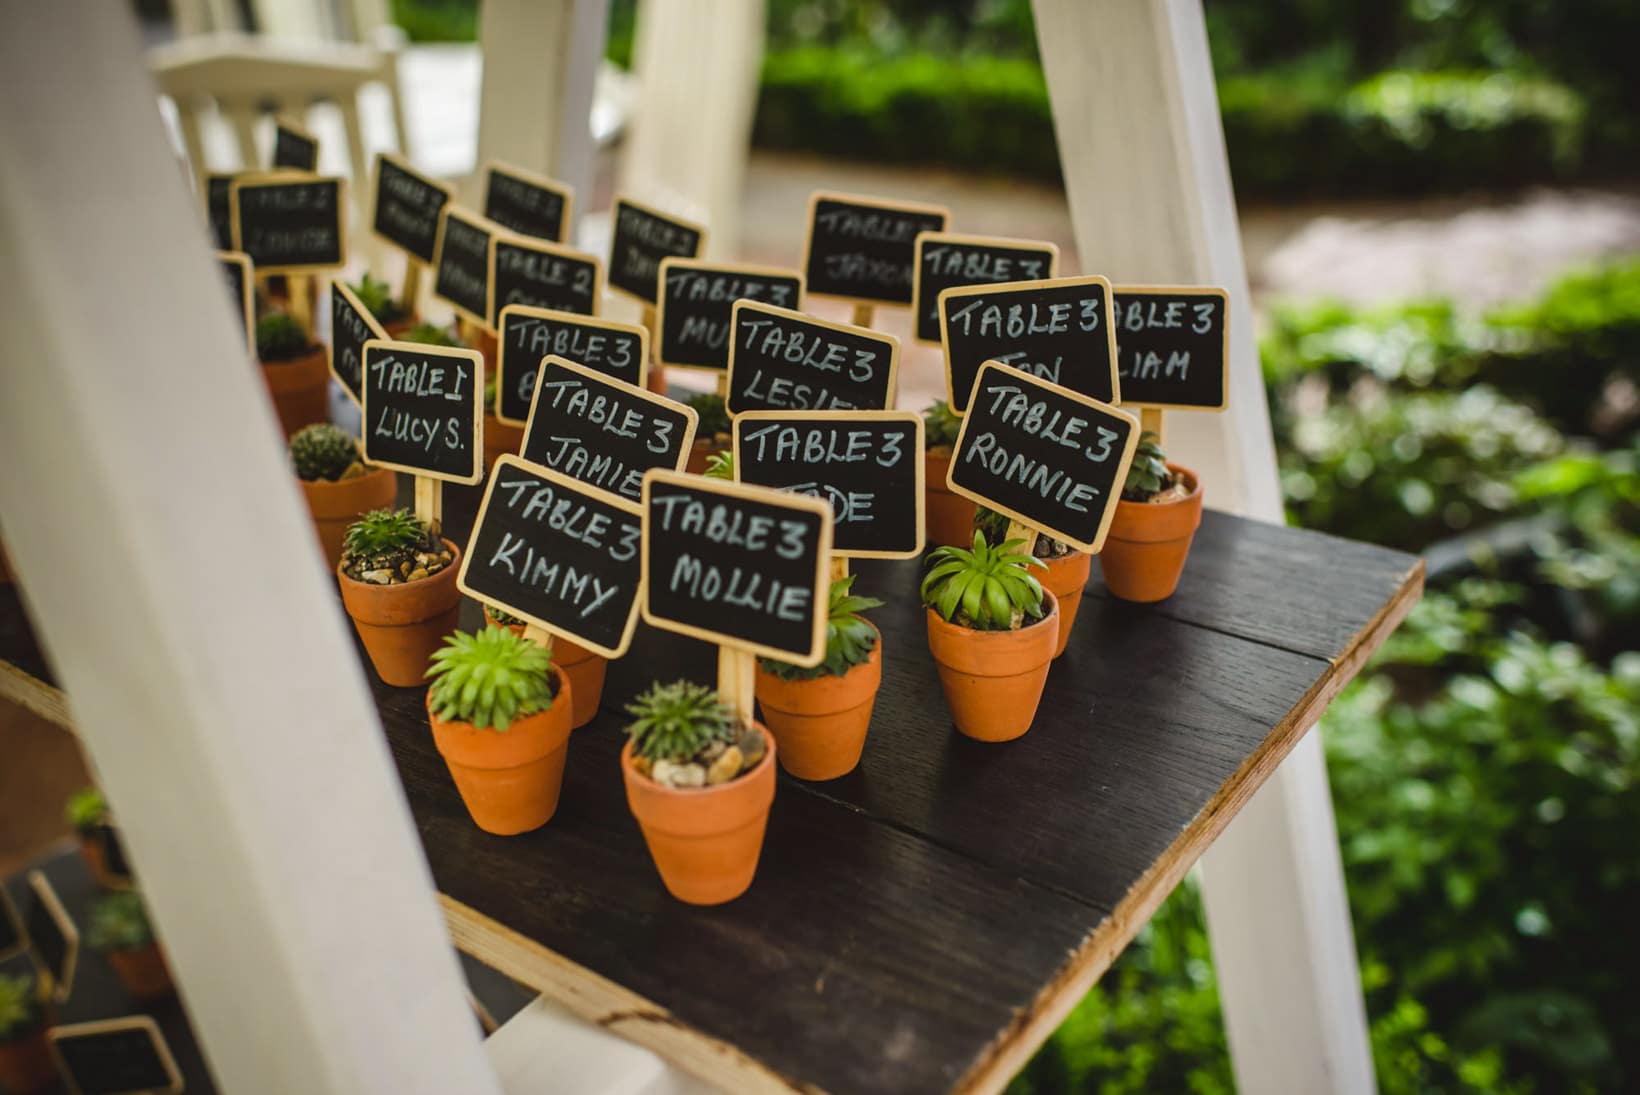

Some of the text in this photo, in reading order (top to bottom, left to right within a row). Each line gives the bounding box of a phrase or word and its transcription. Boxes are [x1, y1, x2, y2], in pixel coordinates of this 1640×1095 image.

[571, 268, 592, 296] 2
[924, 246, 1043, 280] TABLE 3
[509, 320, 632, 367] TABLE 3
[950, 300, 1073, 338] TABLE
[1079, 299, 1099, 332] 3
[1192, 303, 1216, 334] 3
[371, 356, 445, 397] TABLE
[741, 320, 876, 382] TABLE 3
[375, 405, 464, 451] LUCY S.
[546, 381, 643, 438] TABLE
[647, 419, 673, 453] 3
[744, 424, 905, 467] TABLE 3
[987, 385, 1119, 462] TABLE 3
[547, 435, 643, 497] JAMIE
[965, 432, 1100, 513] RONNIE
[501, 481, 641, 561] TABLE 3
[652, 495, 808, 560] TABLE 3
[489, 532, 618, 617] KIMMY
[670, 554, 811, 621] MOLLIE
